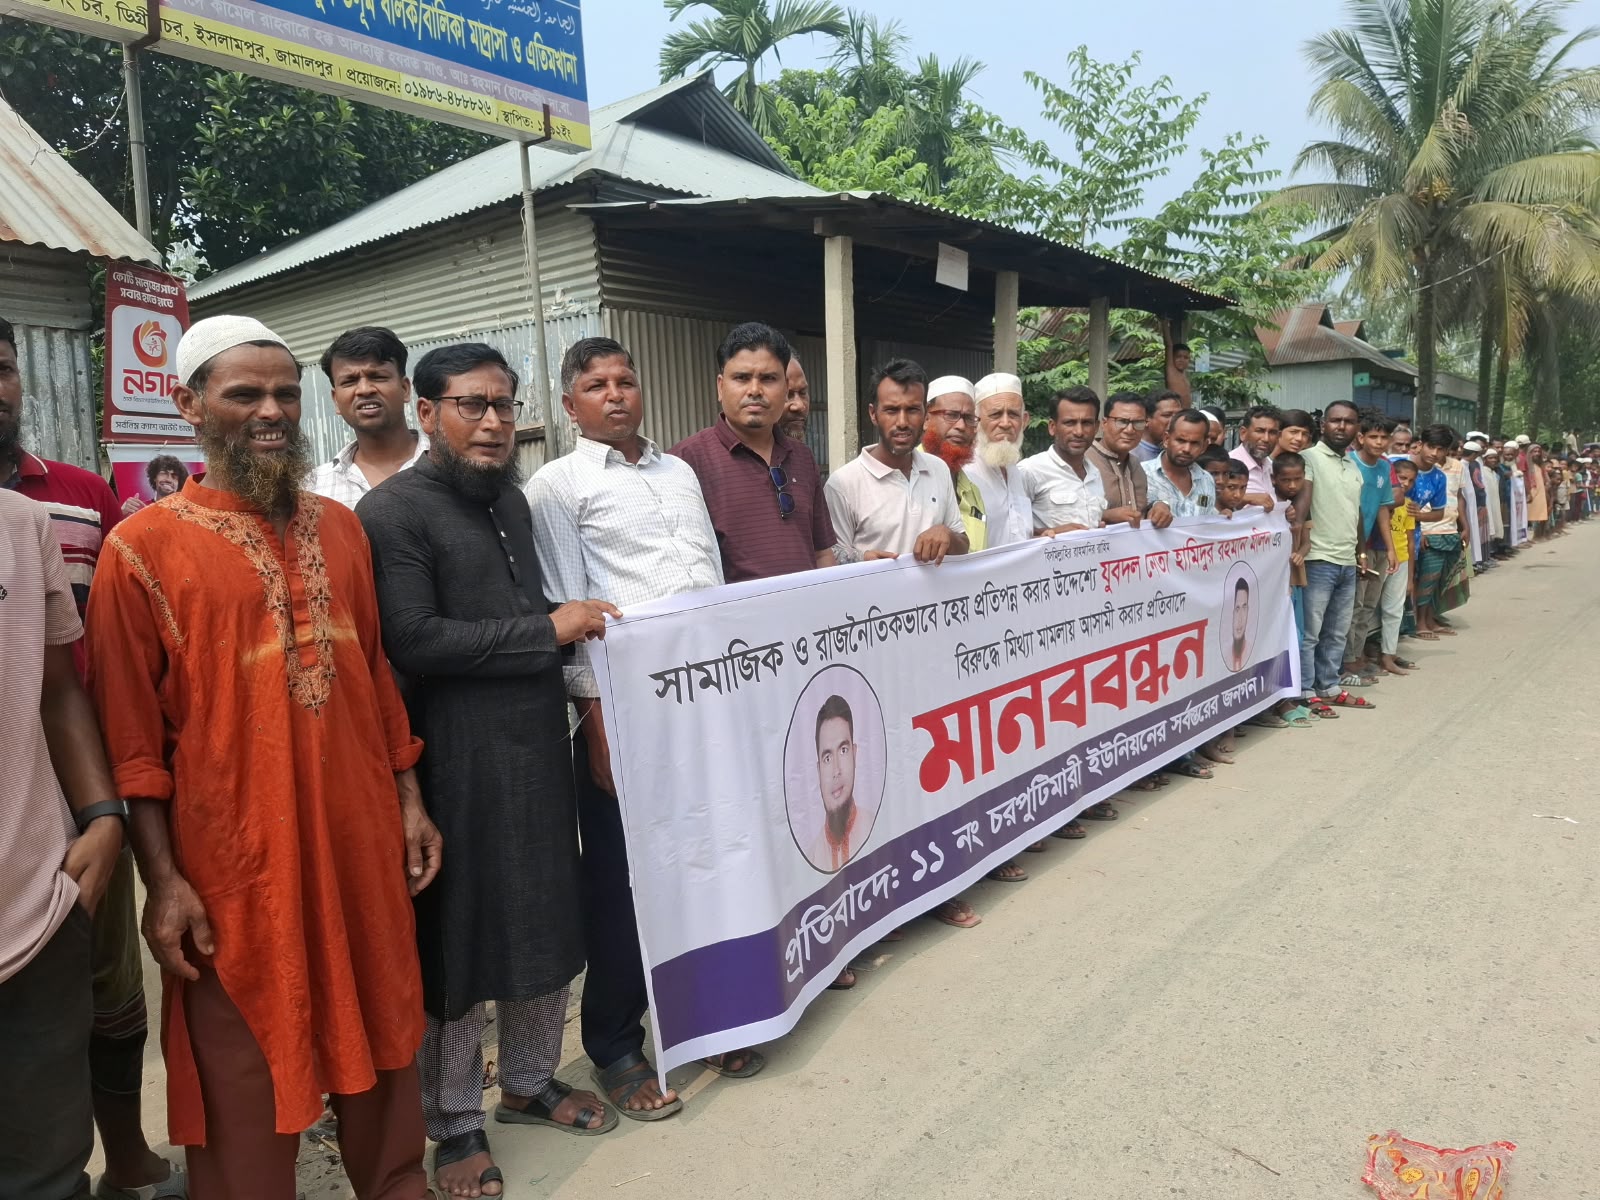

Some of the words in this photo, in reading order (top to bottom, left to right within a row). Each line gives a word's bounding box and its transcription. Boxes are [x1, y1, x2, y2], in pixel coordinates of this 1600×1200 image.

[467, 18, 508, 62] মাদ্রাসা
[511, 36, 522, 63] ও
[525, 31, 578, 85] এতিমখানা
[648, 638, 784, 704] সামাজিক
[792, 637, 809, 665] ও
[813, 605, 939, 661] রাজনৈতিকভাবে
[941, 596, 969, 627] হেয়
[974, 581, 1018, 620] প্রতিপন্ন
[1021, 577, 1050, 604] করার
[1100, 556, 1141, 594] যুবদল
[1145, 551, 1170, 579] নেতা
[1172, 537, 1214, 573] হামিদুর
[1217, 536, 1249, 562] রহমান
[954, 642, 1000, 681] বিরুদ্ধে
[1003, 629, 1034, 664] মিথ্যা
[1037, 619, 1075, 651] মামলায়
[1079, 601, 1115, 639] আসামী
[1118, 601, 1144, 626] করার
[1146, 590, 1186, 621] প্রতিবাদে
[912, 618, 1209, 794] মানববন্ধন
[910, 841, 945, 882] ১১
[952, 820, 984, 853] নং
[986, 755, 1083, 835] চরপুটিমারী
[1085, 719, 1168, 776] ইউনিয়নের
[1169, 700, 1219, 735] সর্বস্তরের
